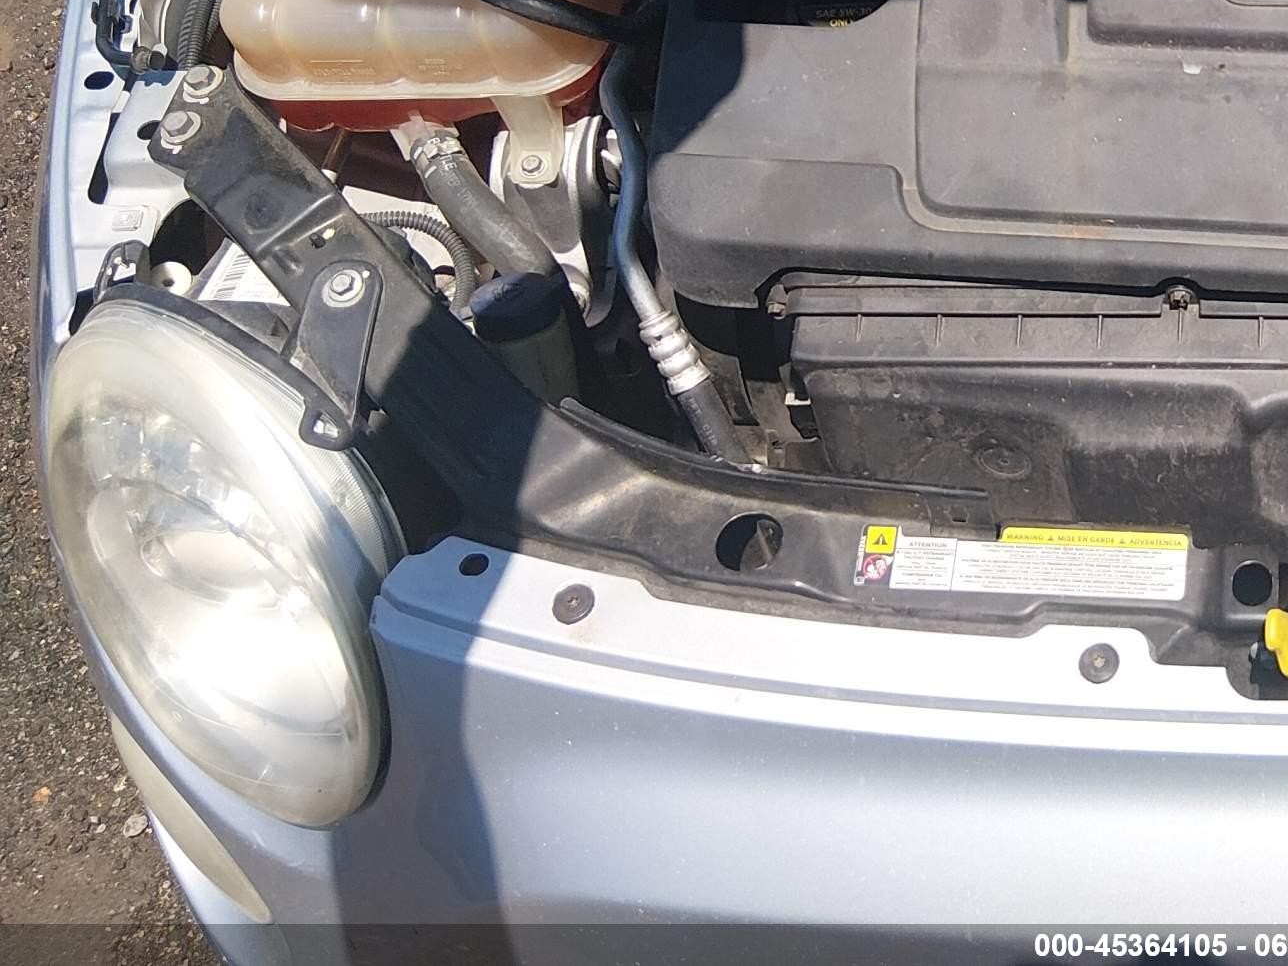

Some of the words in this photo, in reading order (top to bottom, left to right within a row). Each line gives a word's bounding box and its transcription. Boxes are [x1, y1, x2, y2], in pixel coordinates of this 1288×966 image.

[908, 540, 949, 549] ATTENTION
[1006, 534, 1045, 543] WARNING
[1056, 534, 1077, 543] MISE
[1077, 535, 1089, 543] EN
[1089, 535, 1116, 544] GARDE
[1128, 538, 1183, 548] ADVERTENCIA
